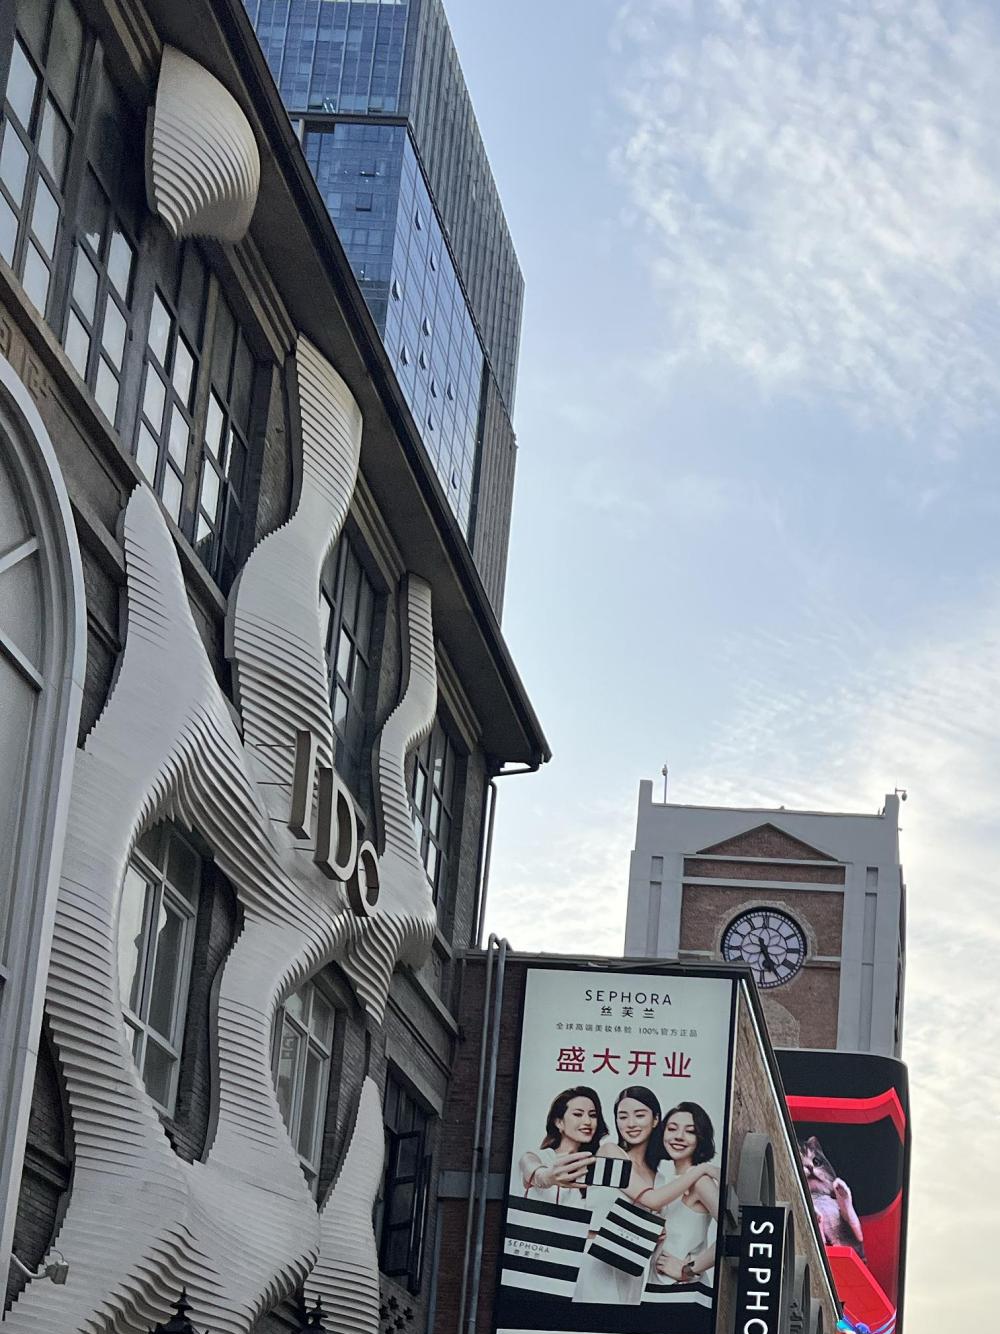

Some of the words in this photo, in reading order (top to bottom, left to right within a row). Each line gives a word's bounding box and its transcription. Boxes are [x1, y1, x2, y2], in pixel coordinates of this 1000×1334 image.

[585, 989, 672, 1006] SEPHORA
[600, 1005, 655, 1019] 丝芙兰
[556, 1022, 633, 1034] 全球高端美妆体验
[555, 1046, 692, 1078] 盛大开业
[507, 1239, 551, 1254] SEPHORA
